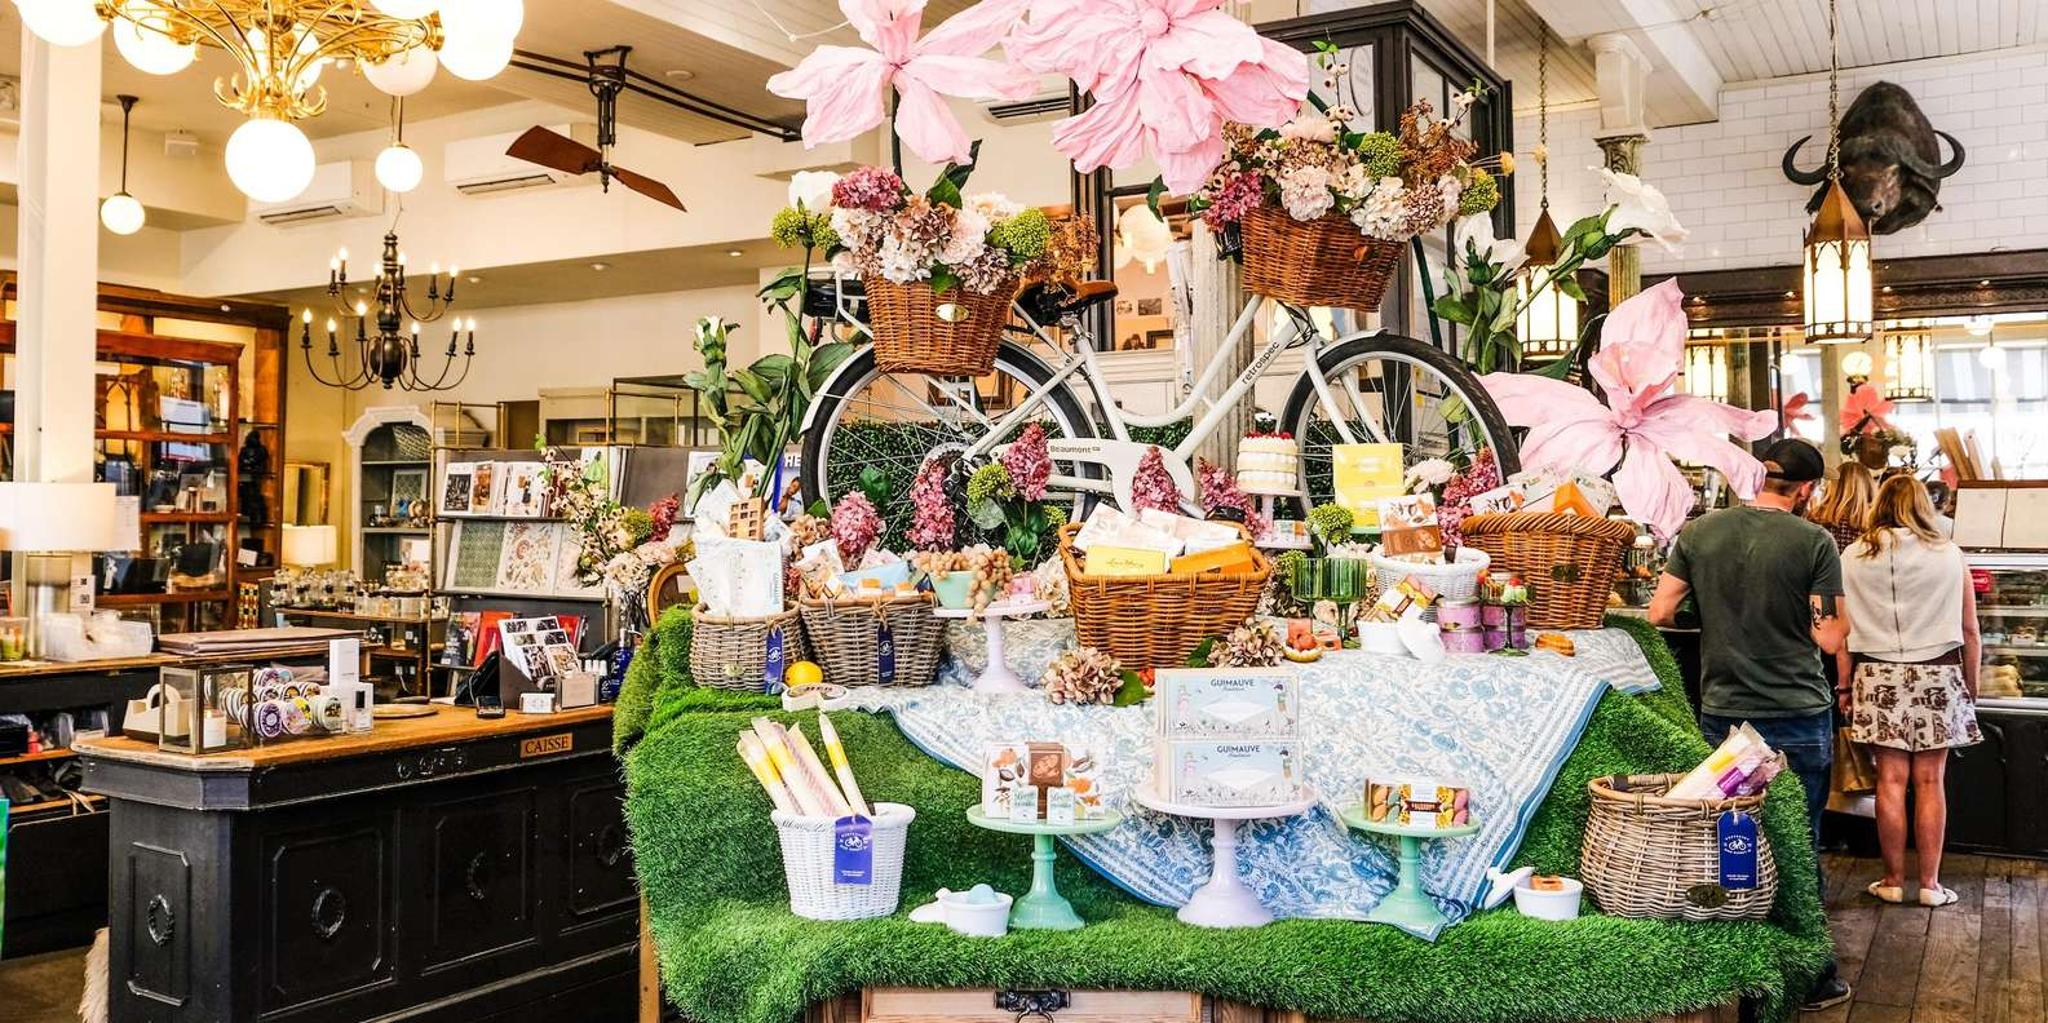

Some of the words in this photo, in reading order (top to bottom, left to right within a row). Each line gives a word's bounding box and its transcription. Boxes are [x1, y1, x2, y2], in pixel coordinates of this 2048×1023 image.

[1242, 341, 1280, 384] retrospec
[1050, 445, 1092, 453] Beaumont
[1210, 678, 1255, 687] GUIMAUVE
[525, 735, 569, 754] CAISSE
[1216, 744, 1261, 753] GUIMAUVE
